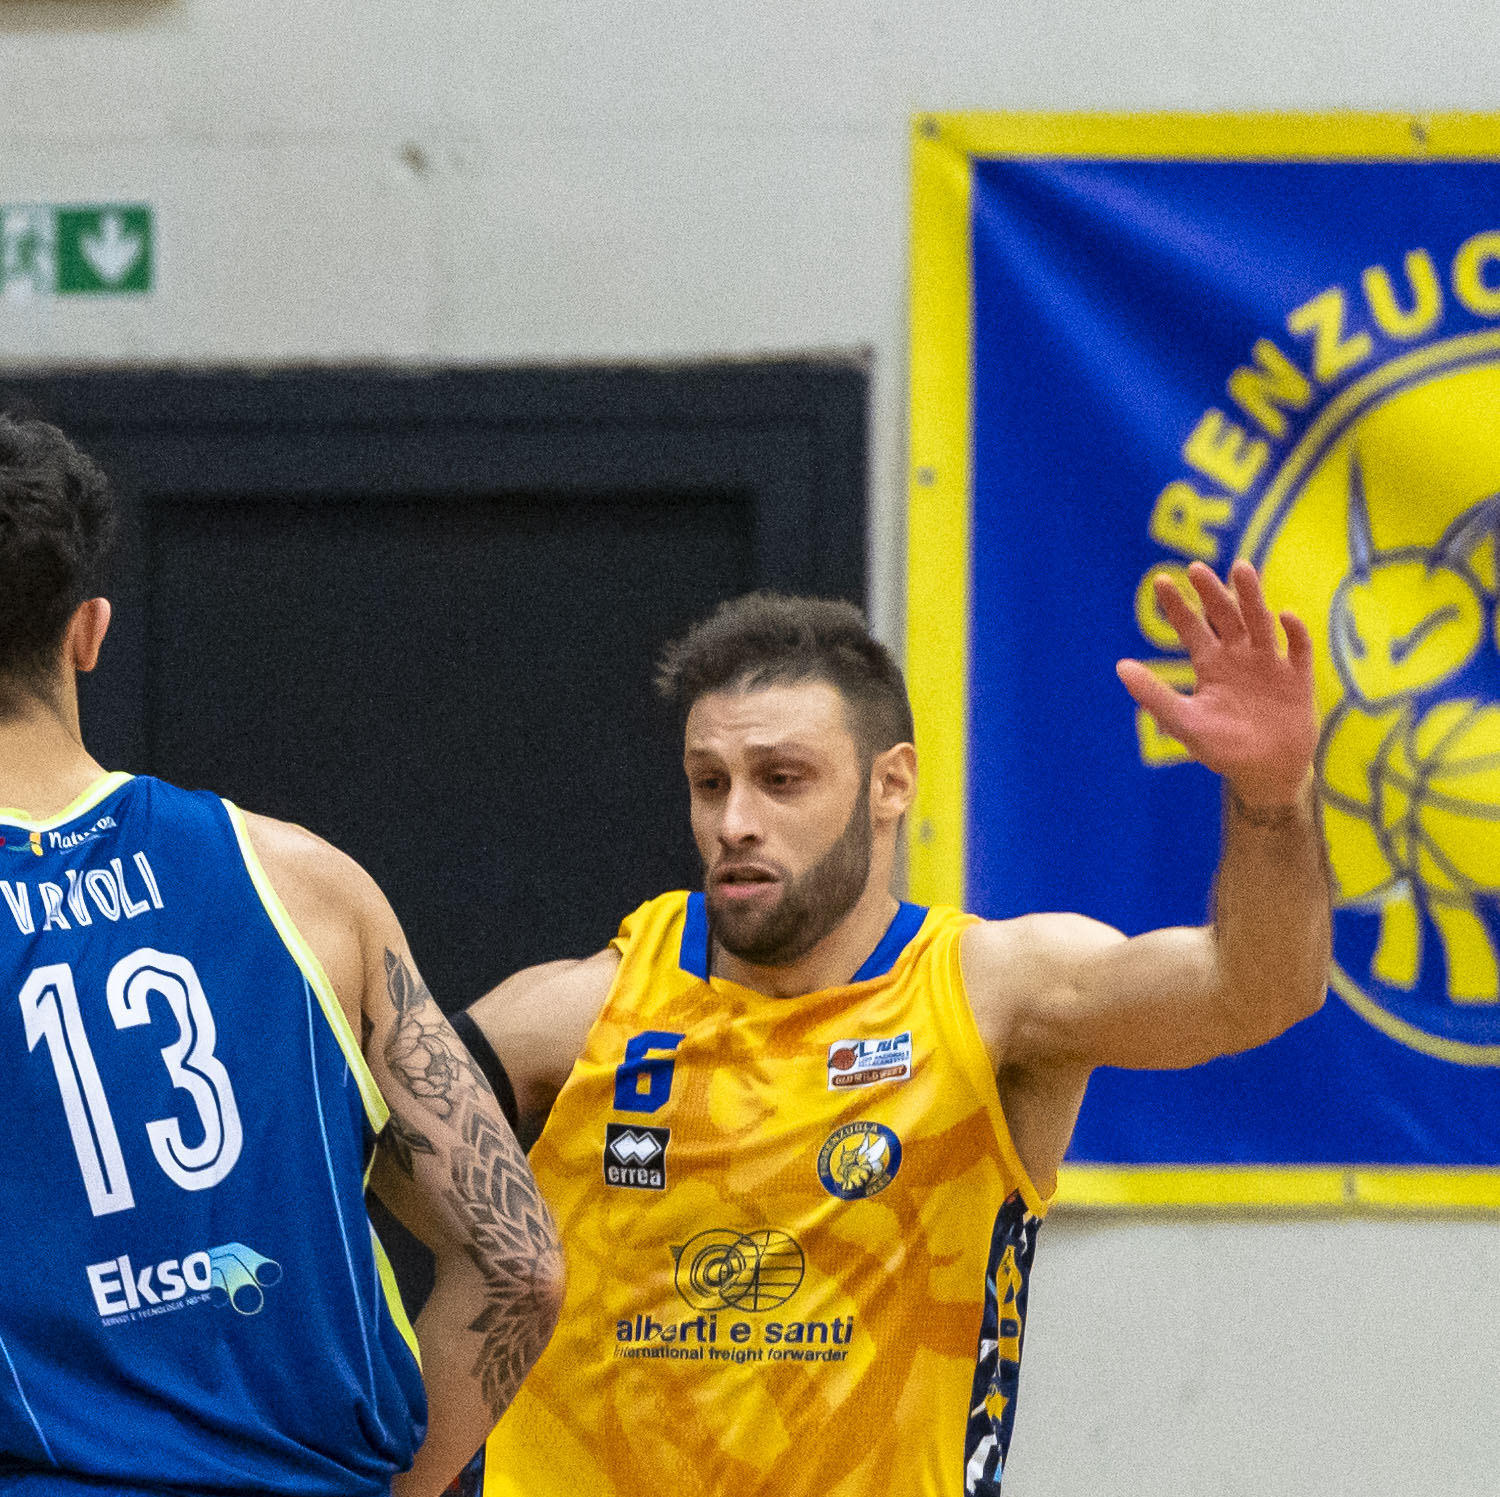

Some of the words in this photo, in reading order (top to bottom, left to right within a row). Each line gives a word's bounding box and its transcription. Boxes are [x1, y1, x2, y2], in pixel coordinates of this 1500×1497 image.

[18, 946, 244, 1218] 13
[613, 1030, 687, 1114] 6
[608, 1165, 662, 1187] errea
[85, 1251, 212, 1317] Ekso
[615, 1313, 717, 1343] alberti
[729, 1321, 752, 1344] e
[764, 1315, 855, 1345] santi
[708, 1347, 763, 1364] freight
[767, 1347, 848, 1362] forwarder
